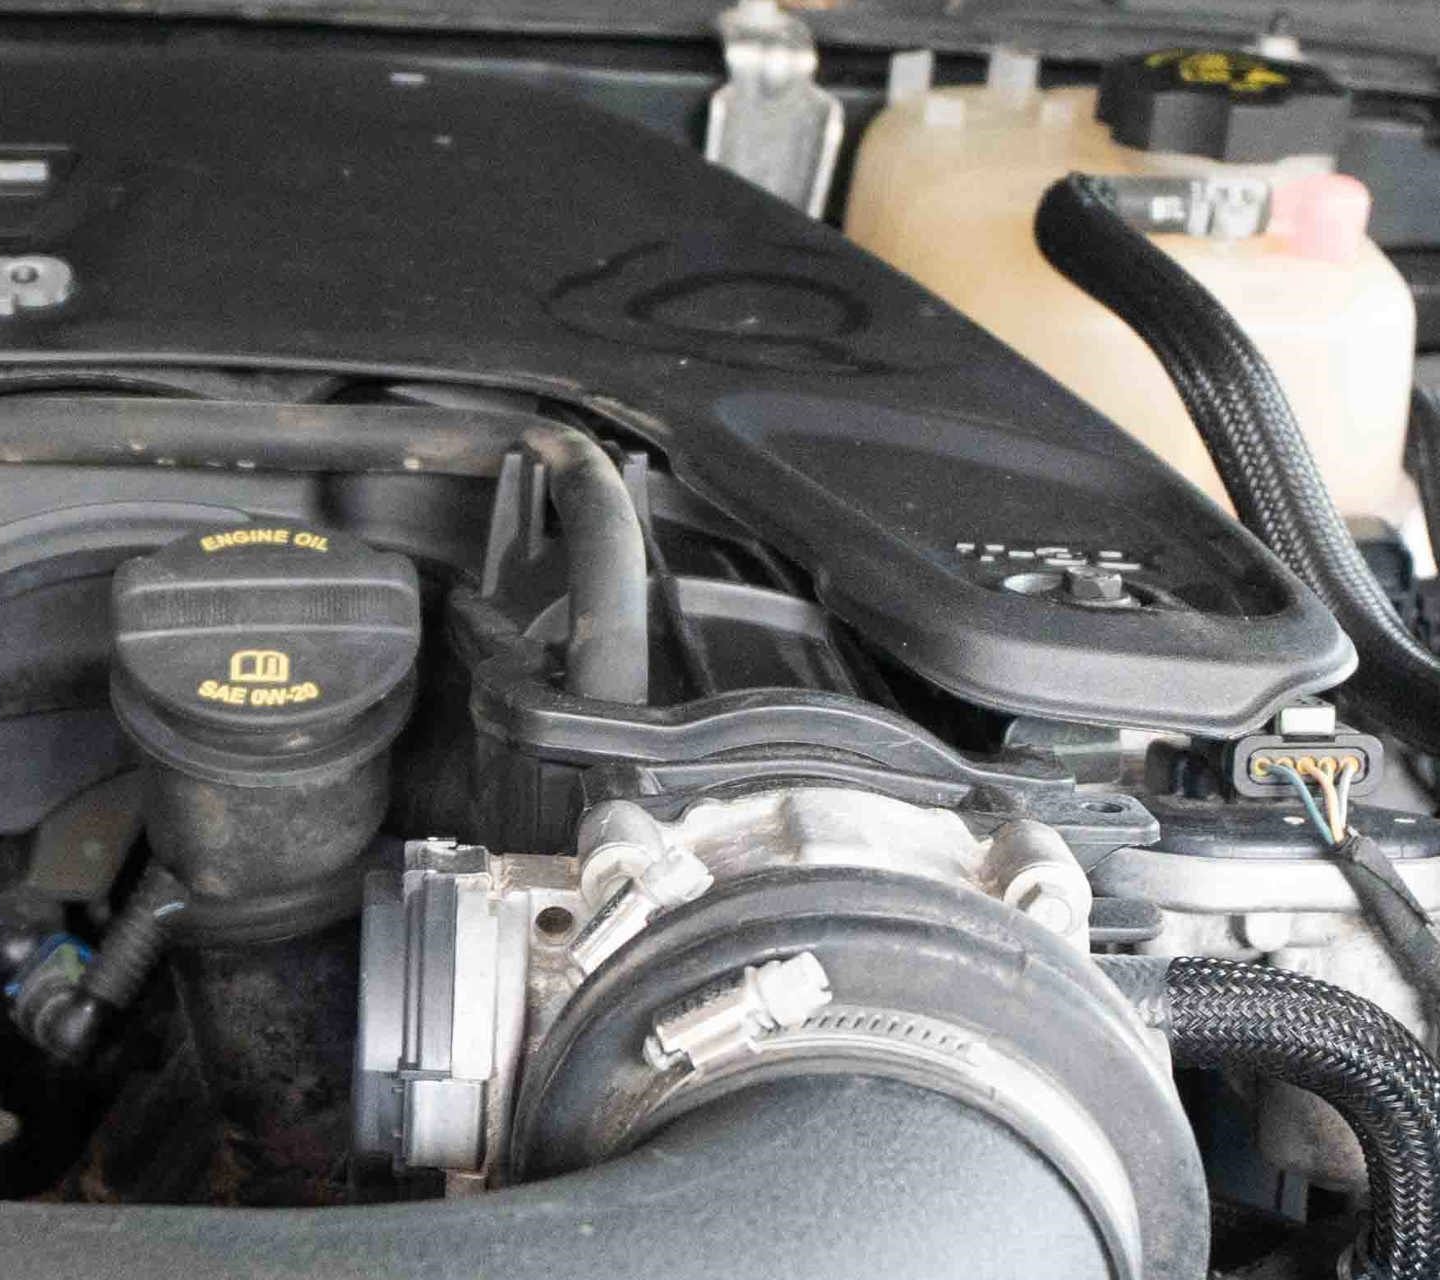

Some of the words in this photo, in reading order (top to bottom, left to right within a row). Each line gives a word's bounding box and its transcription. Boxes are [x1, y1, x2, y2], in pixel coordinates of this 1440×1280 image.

[200, 529, 289, 552] ENGINE
[294, 532, 329, 553] OIL
[198, 680, 247, 705] SAE
[251, 681, 319, 707] 0W-20
